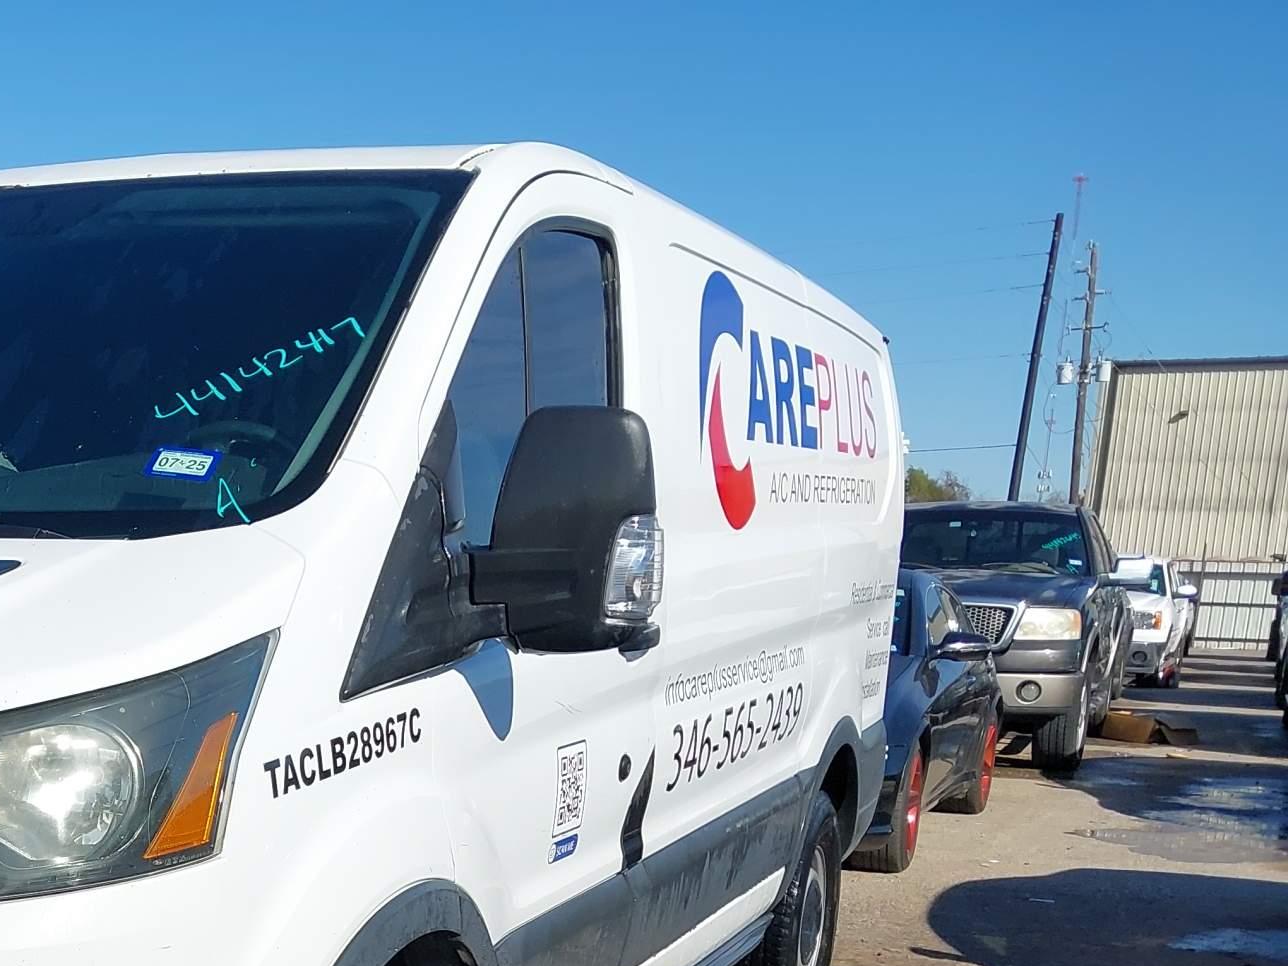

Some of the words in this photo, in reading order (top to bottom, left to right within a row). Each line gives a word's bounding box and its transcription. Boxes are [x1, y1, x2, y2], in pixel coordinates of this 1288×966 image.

[154, 316, 366, 419] 44142417
[789, 472, 812, 503] AND
[813, 474, 876, 505] REFRIGERATION
[664, 644, 805, 706] infocareplusservice@gmail.com
[263, 707, 422, 799] TACLB28967C
[665, 681, 804, 792] 346-565-2439
